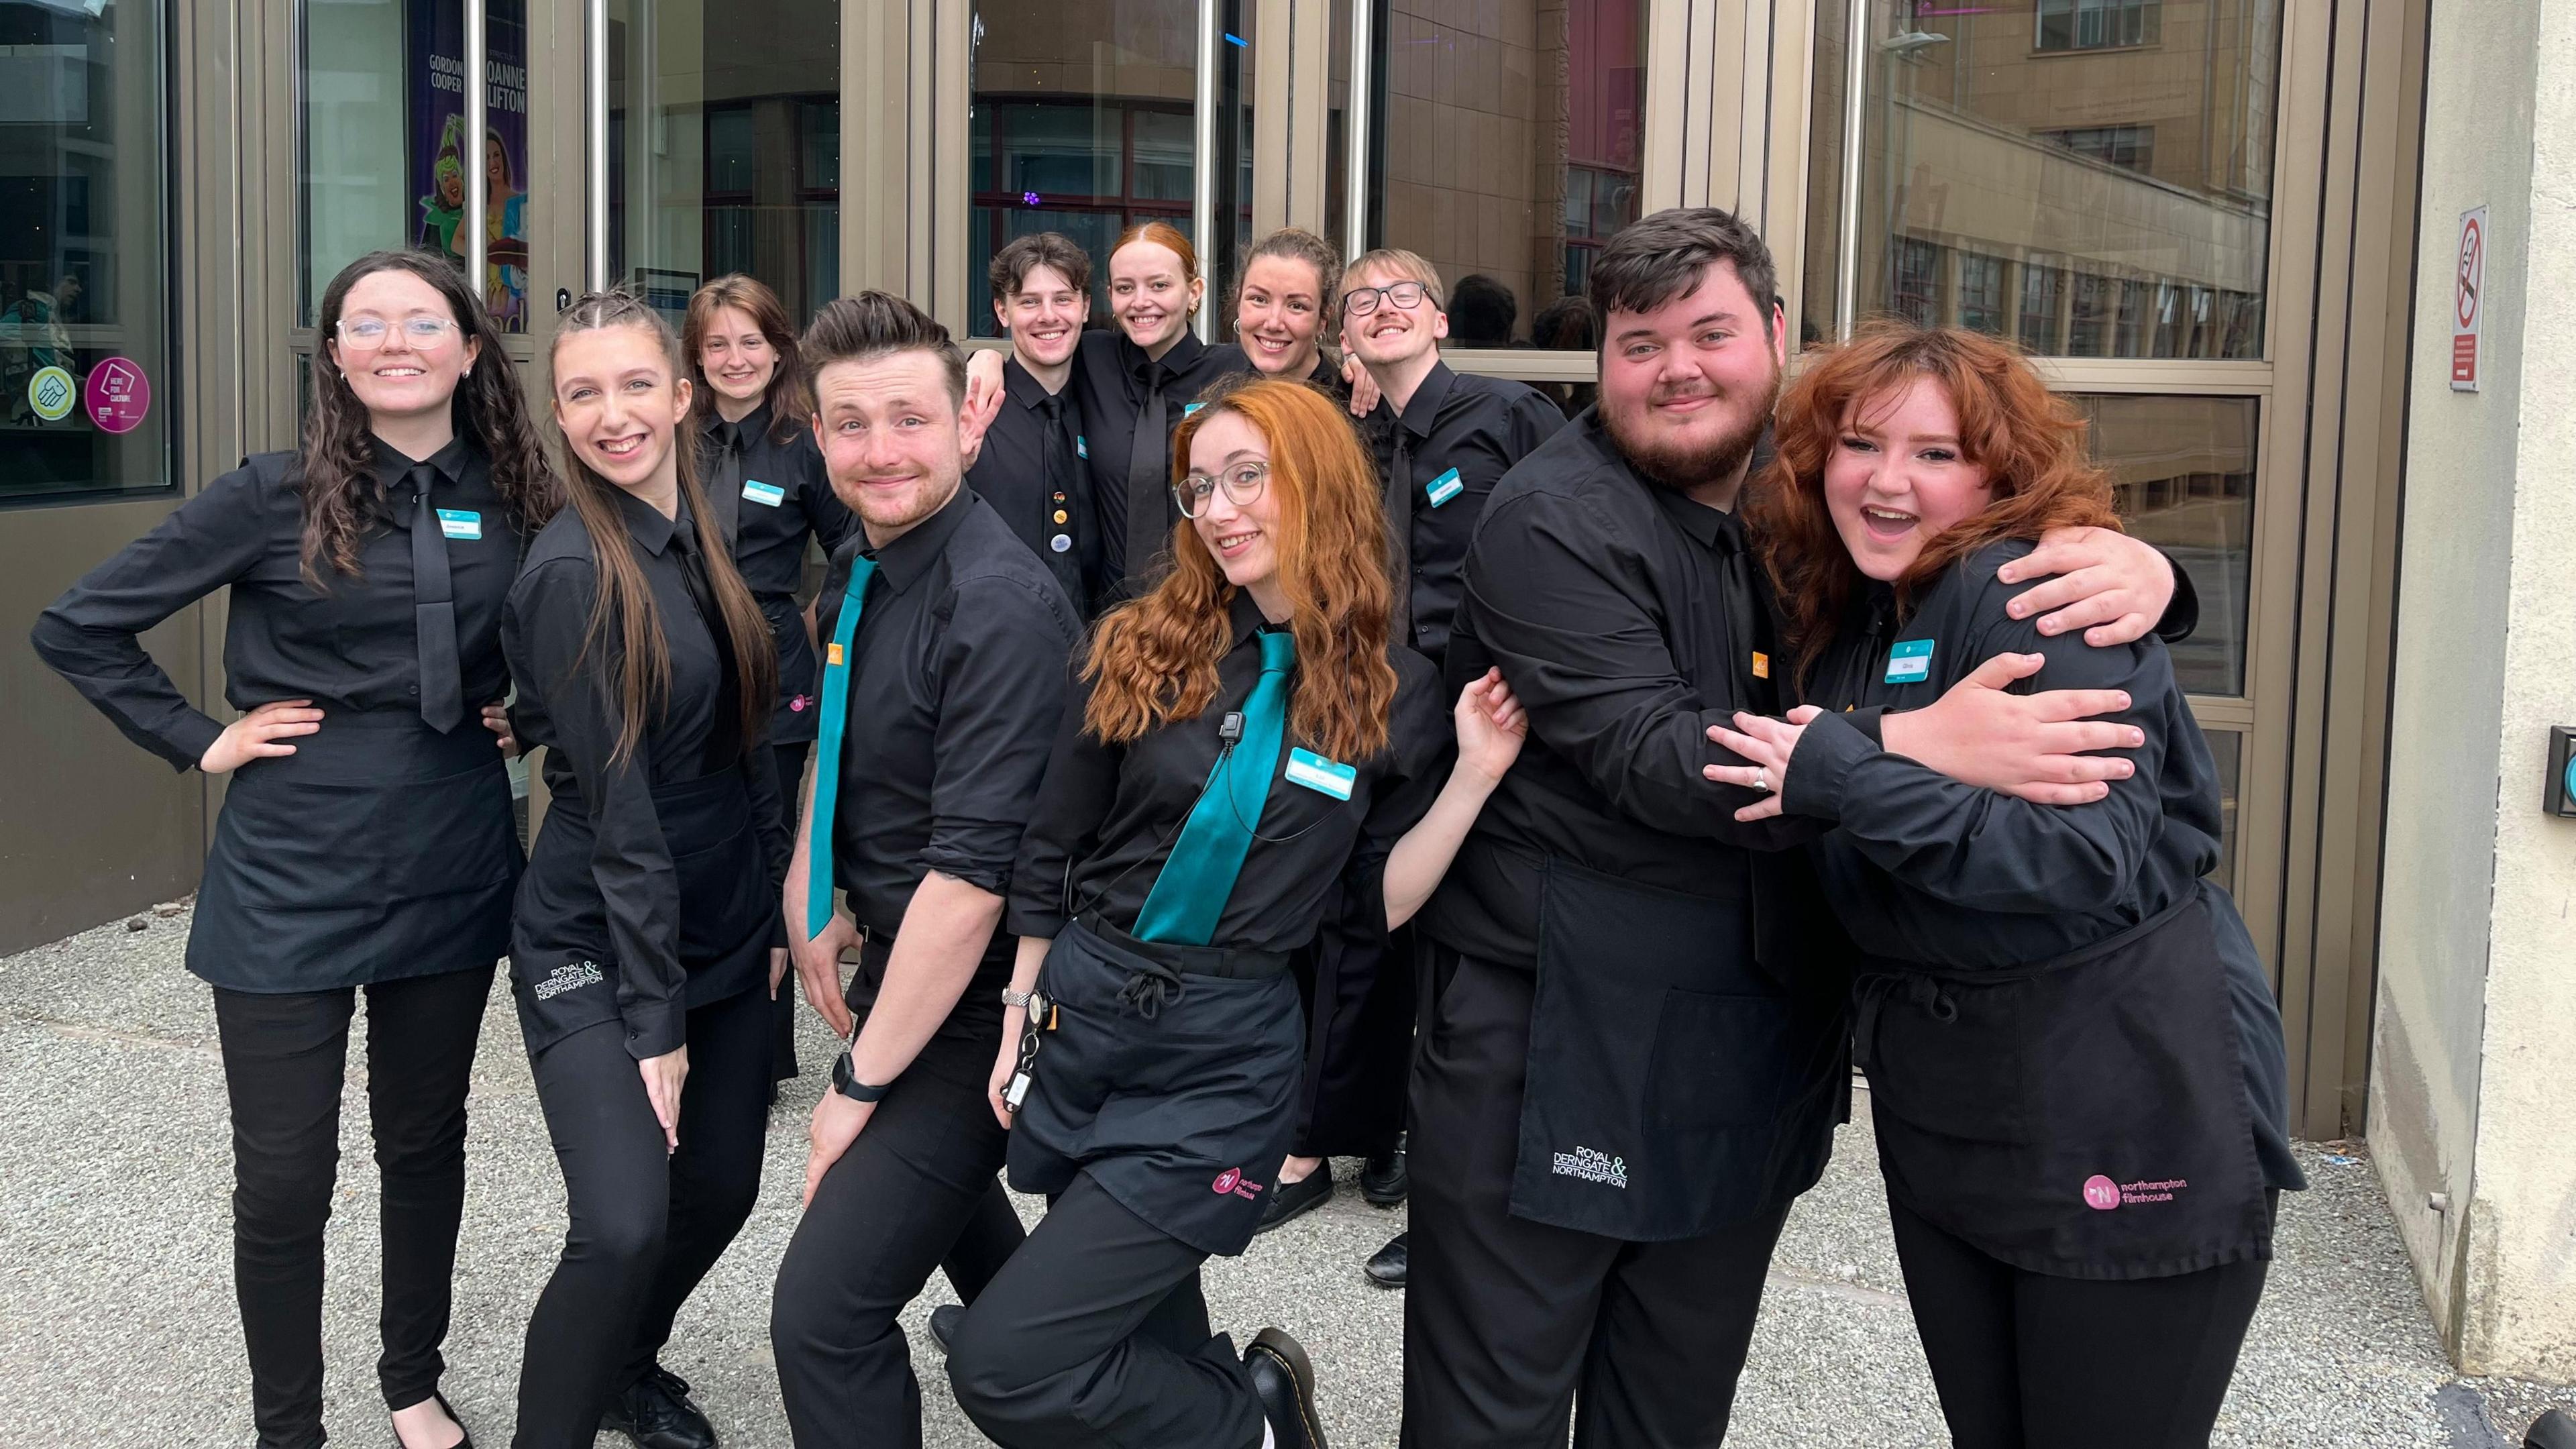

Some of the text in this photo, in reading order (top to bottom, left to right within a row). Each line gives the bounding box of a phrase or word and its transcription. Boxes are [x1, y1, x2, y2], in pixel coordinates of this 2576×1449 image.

[429, 54, 463, 76] GORDON
[486, 60, 525, 91] OANNE
[431, 72, 462, 93] COOPER
[487, 85, 525, 114] LIFTON
[551, 961, 601, 977] ROYAL &
[534, 971, 586, 993] DERNGATE
[537, 973, 604, 1002] NORTHAMPTON
[1554, 1152, 1611, 1174] DERNGATE
[1576, 1146, 1627, 1179] ROYAL &
[1552, 1165, 1627, 1189] NORTHAMPTON
[2121, 1179, 2187, 1193] northampton
[2122, 1192, 2174, 1204] filmhouse
